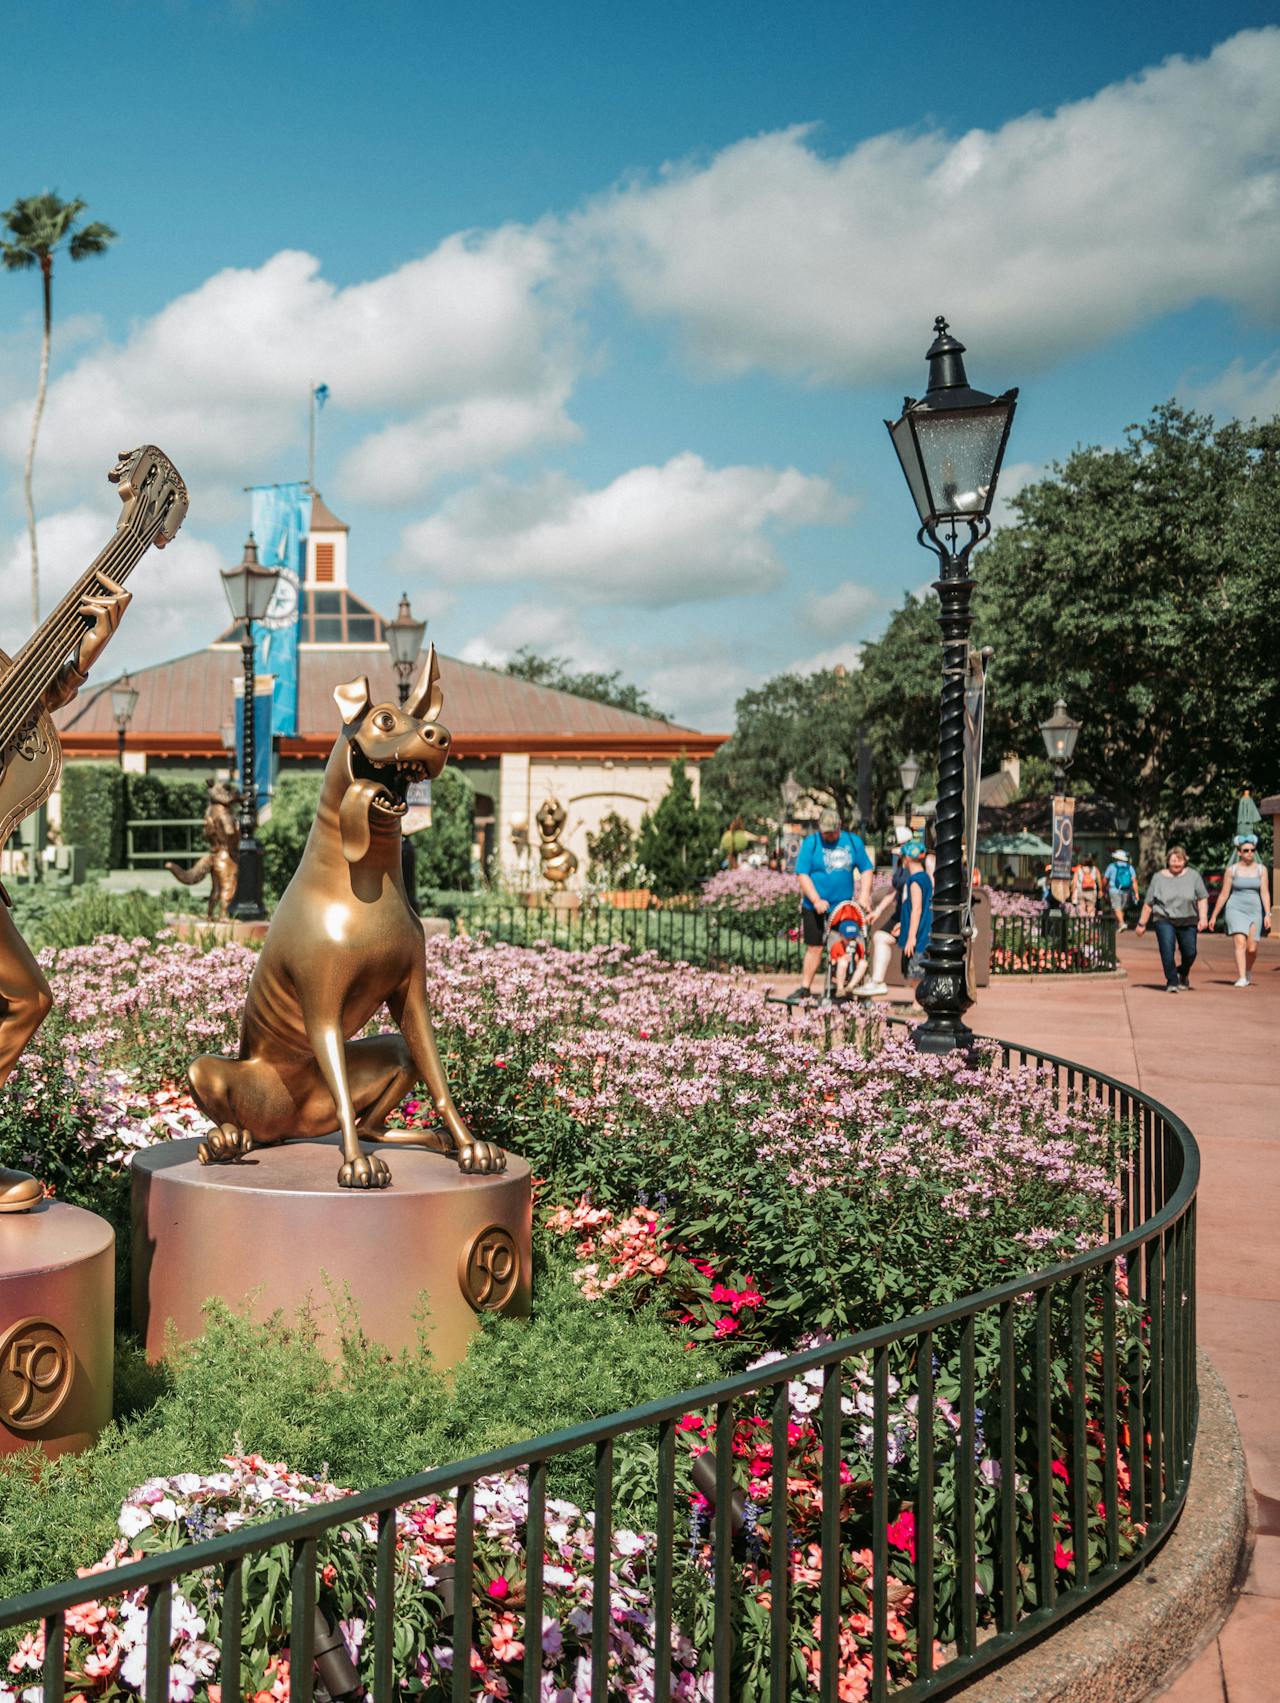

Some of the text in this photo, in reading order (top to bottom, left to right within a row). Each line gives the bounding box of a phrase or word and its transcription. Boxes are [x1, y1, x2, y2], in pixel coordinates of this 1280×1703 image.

[1054, 816, 1072, 858] 50
[476, 1240, 513, 1302] 50
[9, 1338, 62, 1415] 50
